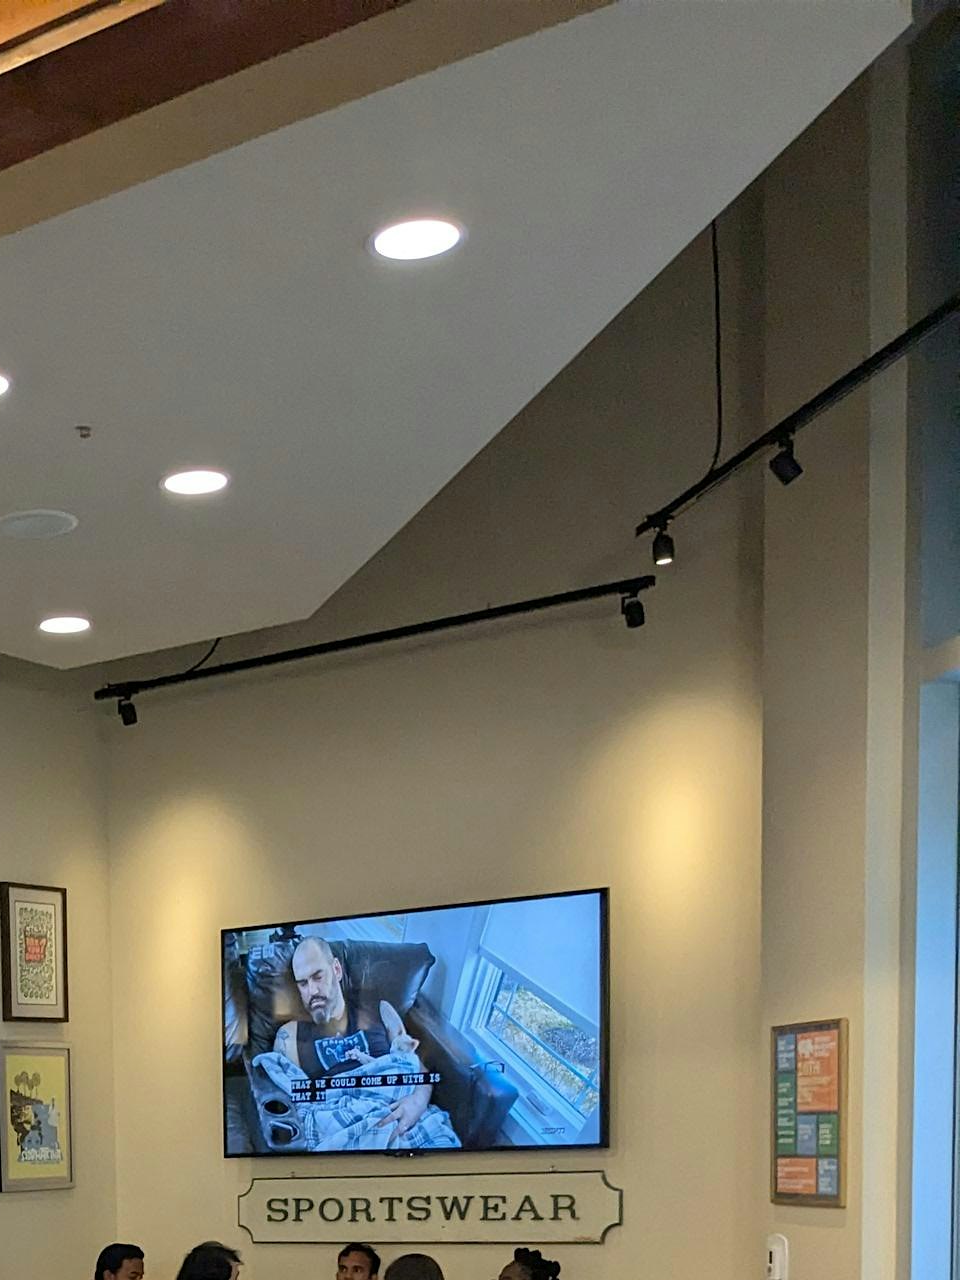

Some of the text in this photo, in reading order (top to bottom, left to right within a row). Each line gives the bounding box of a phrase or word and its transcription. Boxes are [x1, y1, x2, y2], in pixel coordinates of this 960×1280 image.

[292, 1073, 440, 1090] THAT WE COULD COME UP WITH IS
[291, 1090, 326, 1102] THAT IT
[266, 1194, 581, 1222] SPORTSWEAR
